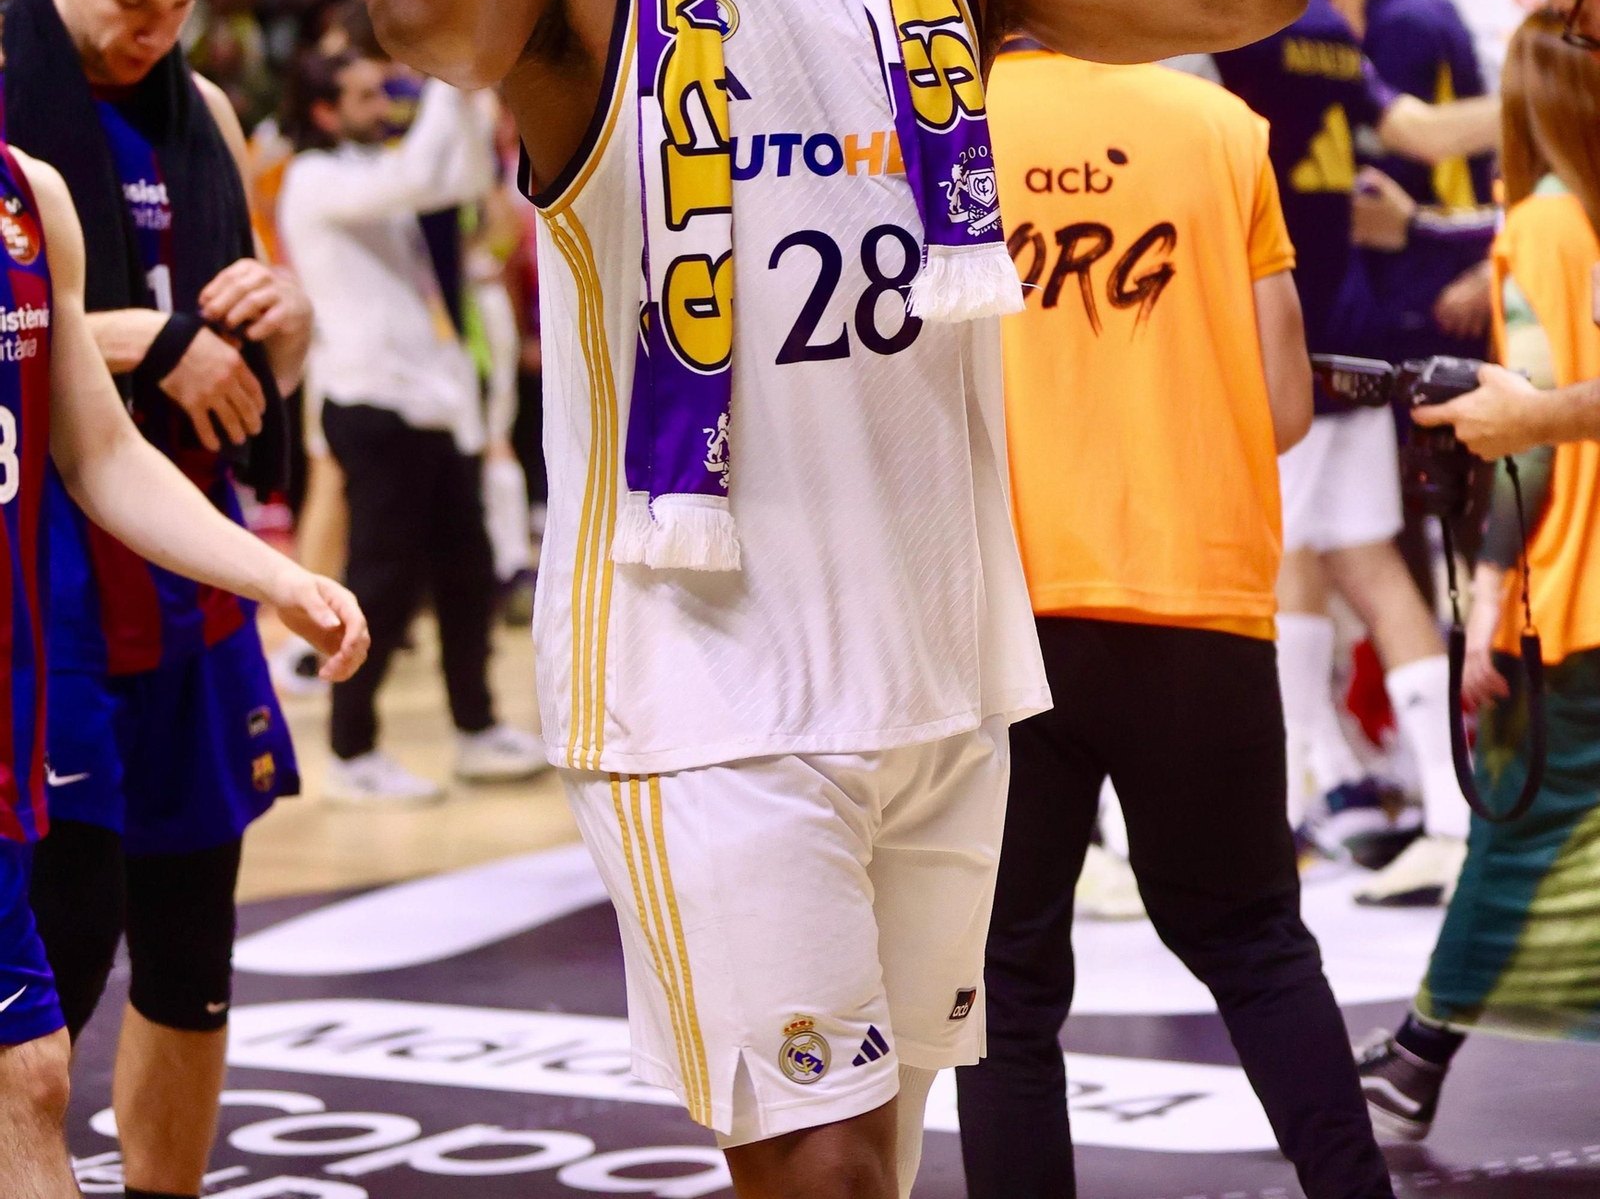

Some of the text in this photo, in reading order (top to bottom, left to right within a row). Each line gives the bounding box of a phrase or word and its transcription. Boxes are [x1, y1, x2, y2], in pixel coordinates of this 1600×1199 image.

[958, 144, 994, 164] 200
[1025, 161, 1113, 194] acb
[768, 223, 925, 366] 28
